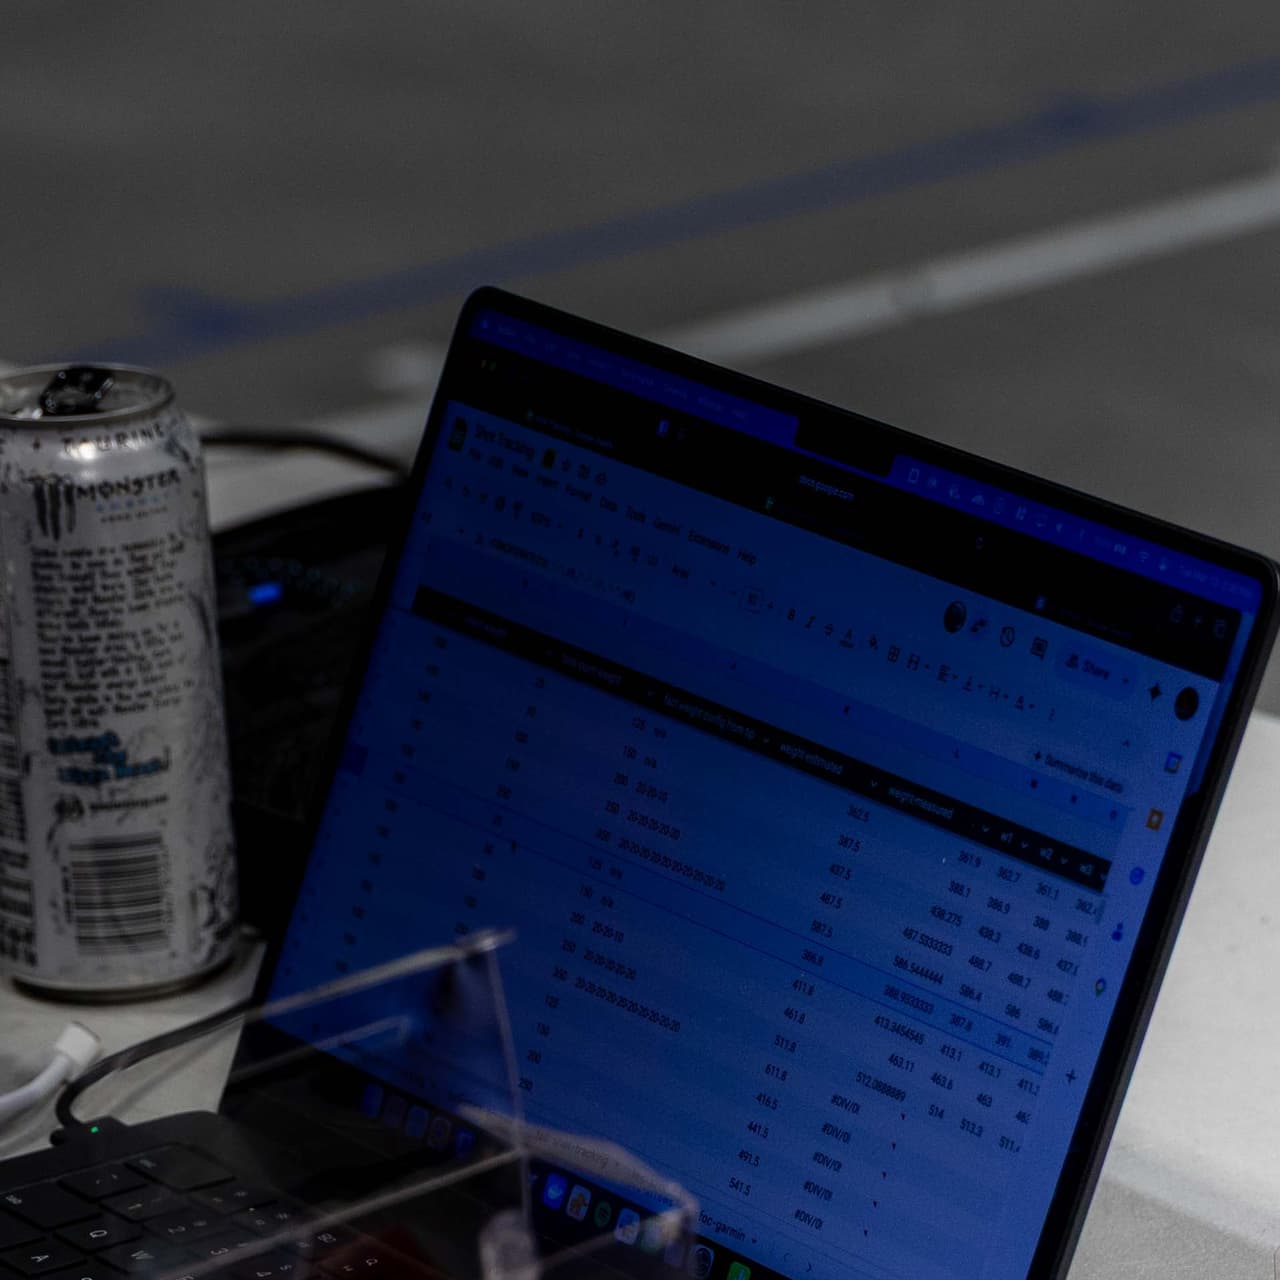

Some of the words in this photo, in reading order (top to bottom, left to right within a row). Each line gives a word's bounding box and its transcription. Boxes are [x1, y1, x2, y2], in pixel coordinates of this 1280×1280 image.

[75, 468, 181, 500] MONSTER
[798, 473, 857, 503] docs.google.com
[685, 529, 732, 557] Extensions
[734, 547, 759, 568] Help
[1080, 658, 1112, 682] Share
[836, 833, 861, 853] 387.5
[818, 890, 843, 910] 487.5
[938, 1042, 963, 1062] 413.1
[977, 1059, 1002, 1080] 413.1
[886, 1052, 915, 1074] 463.11
[929, 1070, 955, 1091] 463.6
[975, 1090, 994, 1108] 463
[754, 1091, 779, 1111] 416.5
[821, 1123, 851, 1144] #DIV/0!
[831, 1094, 861, 1115] #DIV/0!
[926, 1103, 945, 1121] 514
[958, 1117, 984, 1138] 513.3
[745, 1119, 770, 1140] 441.5
[812, 1151, 842, 1172] #DIV/0!
[736, 1147, 761, 1168] 491.5
[803, 1181, 833, 1200] #DIV/0!
[727, 1176, 752, 1197] 541.5
[794, 1209, 823, 1230] #DIV/0!
[697, 1210, 746, 1242] foc-garmin
